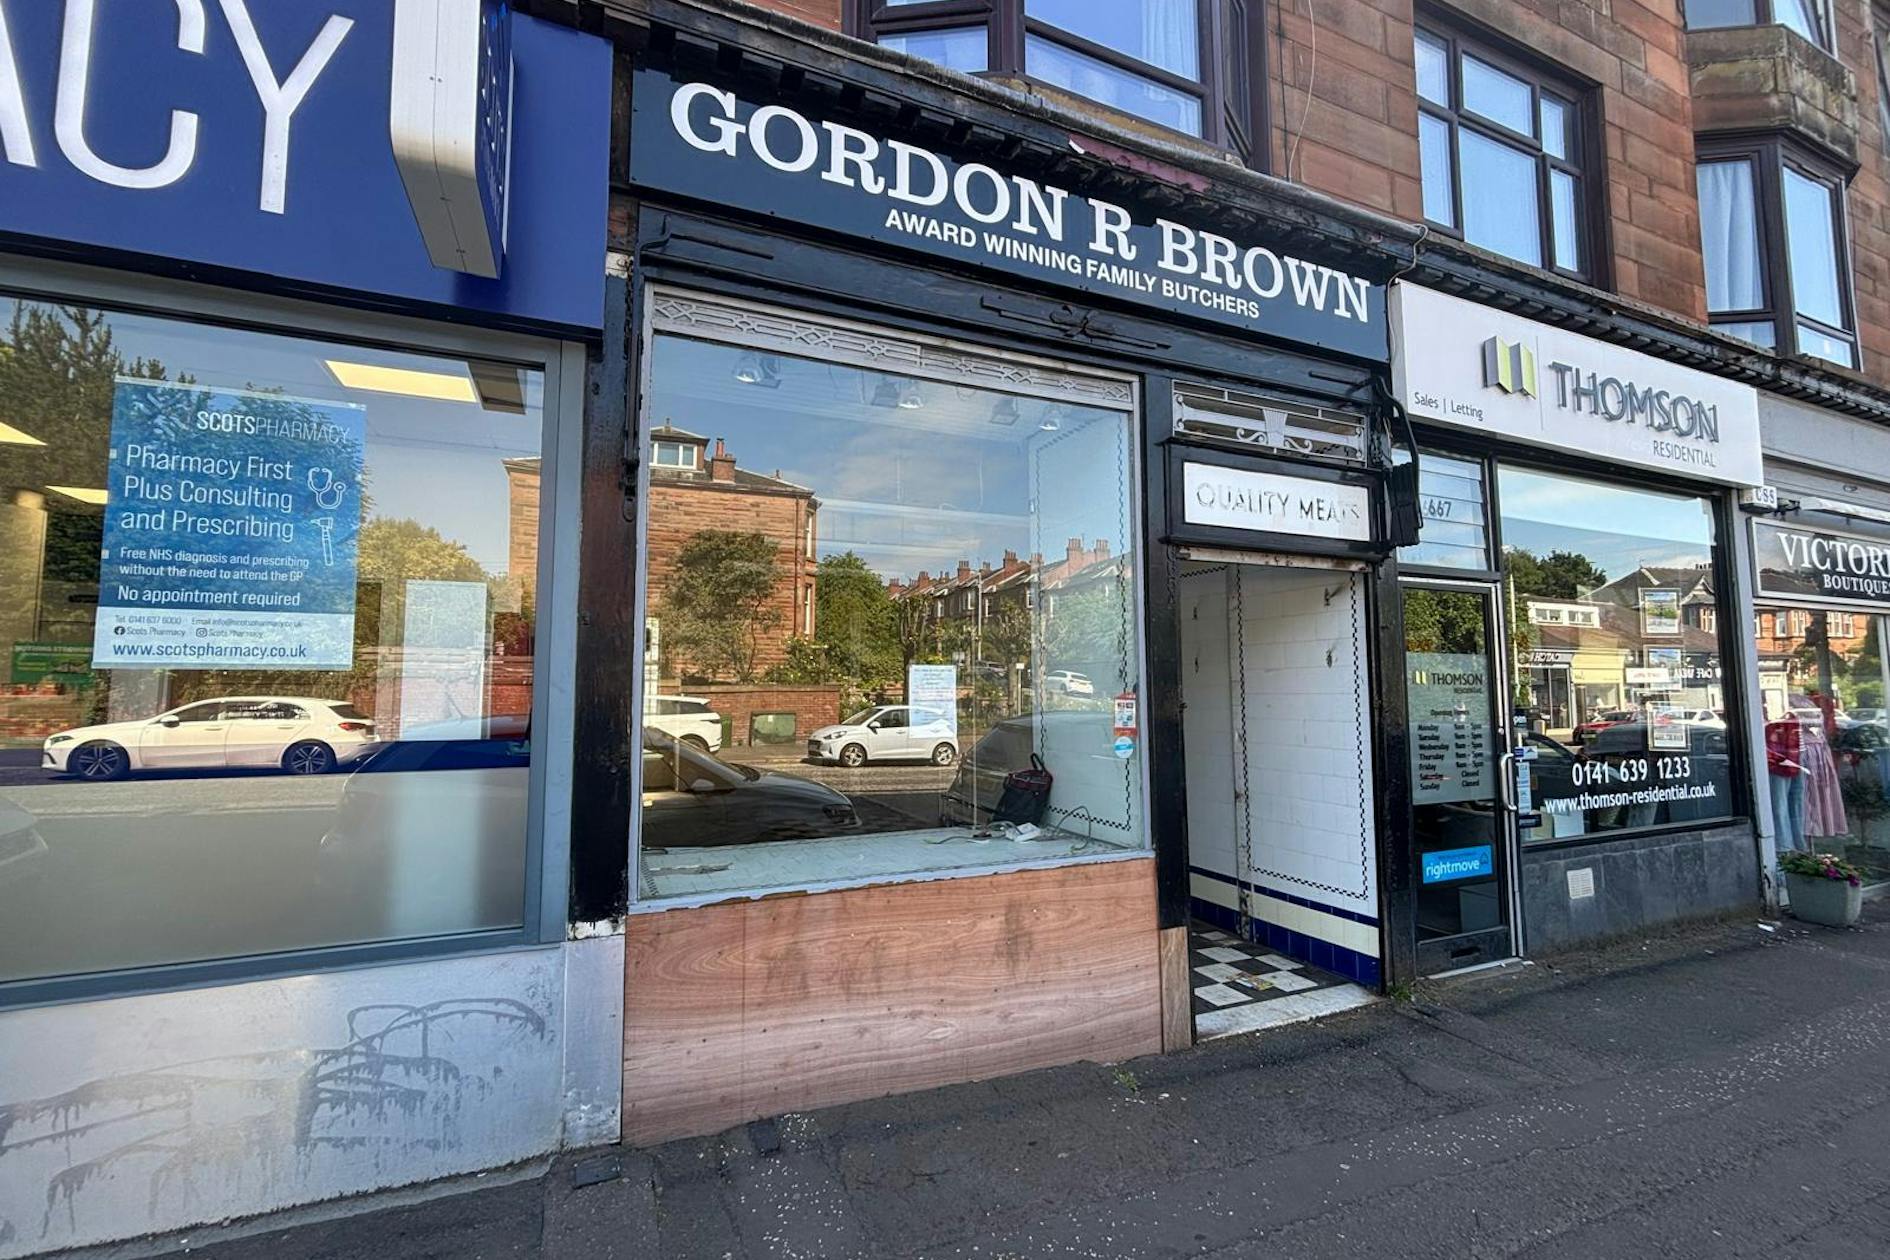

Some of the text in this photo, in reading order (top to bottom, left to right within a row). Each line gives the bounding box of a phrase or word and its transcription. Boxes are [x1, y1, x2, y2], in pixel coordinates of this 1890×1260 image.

[670, 83, 1370, 323] GORDON R BROWN
[885, 208, 1260, 319] AWARD WINNING FAMILY BUTCHERS
[1414, 391, 1484, 422] Sales Letting
[1549, 361, 1720, 443] THOMSON
[197, 411, 350, 444] SCOTSPHARMACY
[126, 444, 293, 480] Pharmacy First
[1653, 440, 1717, 468] RESIDENTIAL
[124, 476, 293, 513] Plus Consulting
[1197, 483, 1289, 517] QUALITY
[1428, 499, 1452, 517] 667
[121, 510, 294, 542] and Prescribing
[120, 547, 309, 569] Free NHS diagnosis and prescribing
[120, 565, 303, 582] without the need to attend the GP
[1823, 574, 1890, 598] BOUTIQUE
[118, 585, 300, 608] No appointment required
[150, 627, 186, 637] Pharmacy
[113, 643, 306, 659] www.scotspharmacy.co.uk
[1431, 673, 1483, 685] THOMSON
[1572, 756, 1691, 786] 0141 639 1233
[1544, 781, 1716, 814] www.thomson-residential.co.uk
[1426, 860, 1480, 879] rightmove
